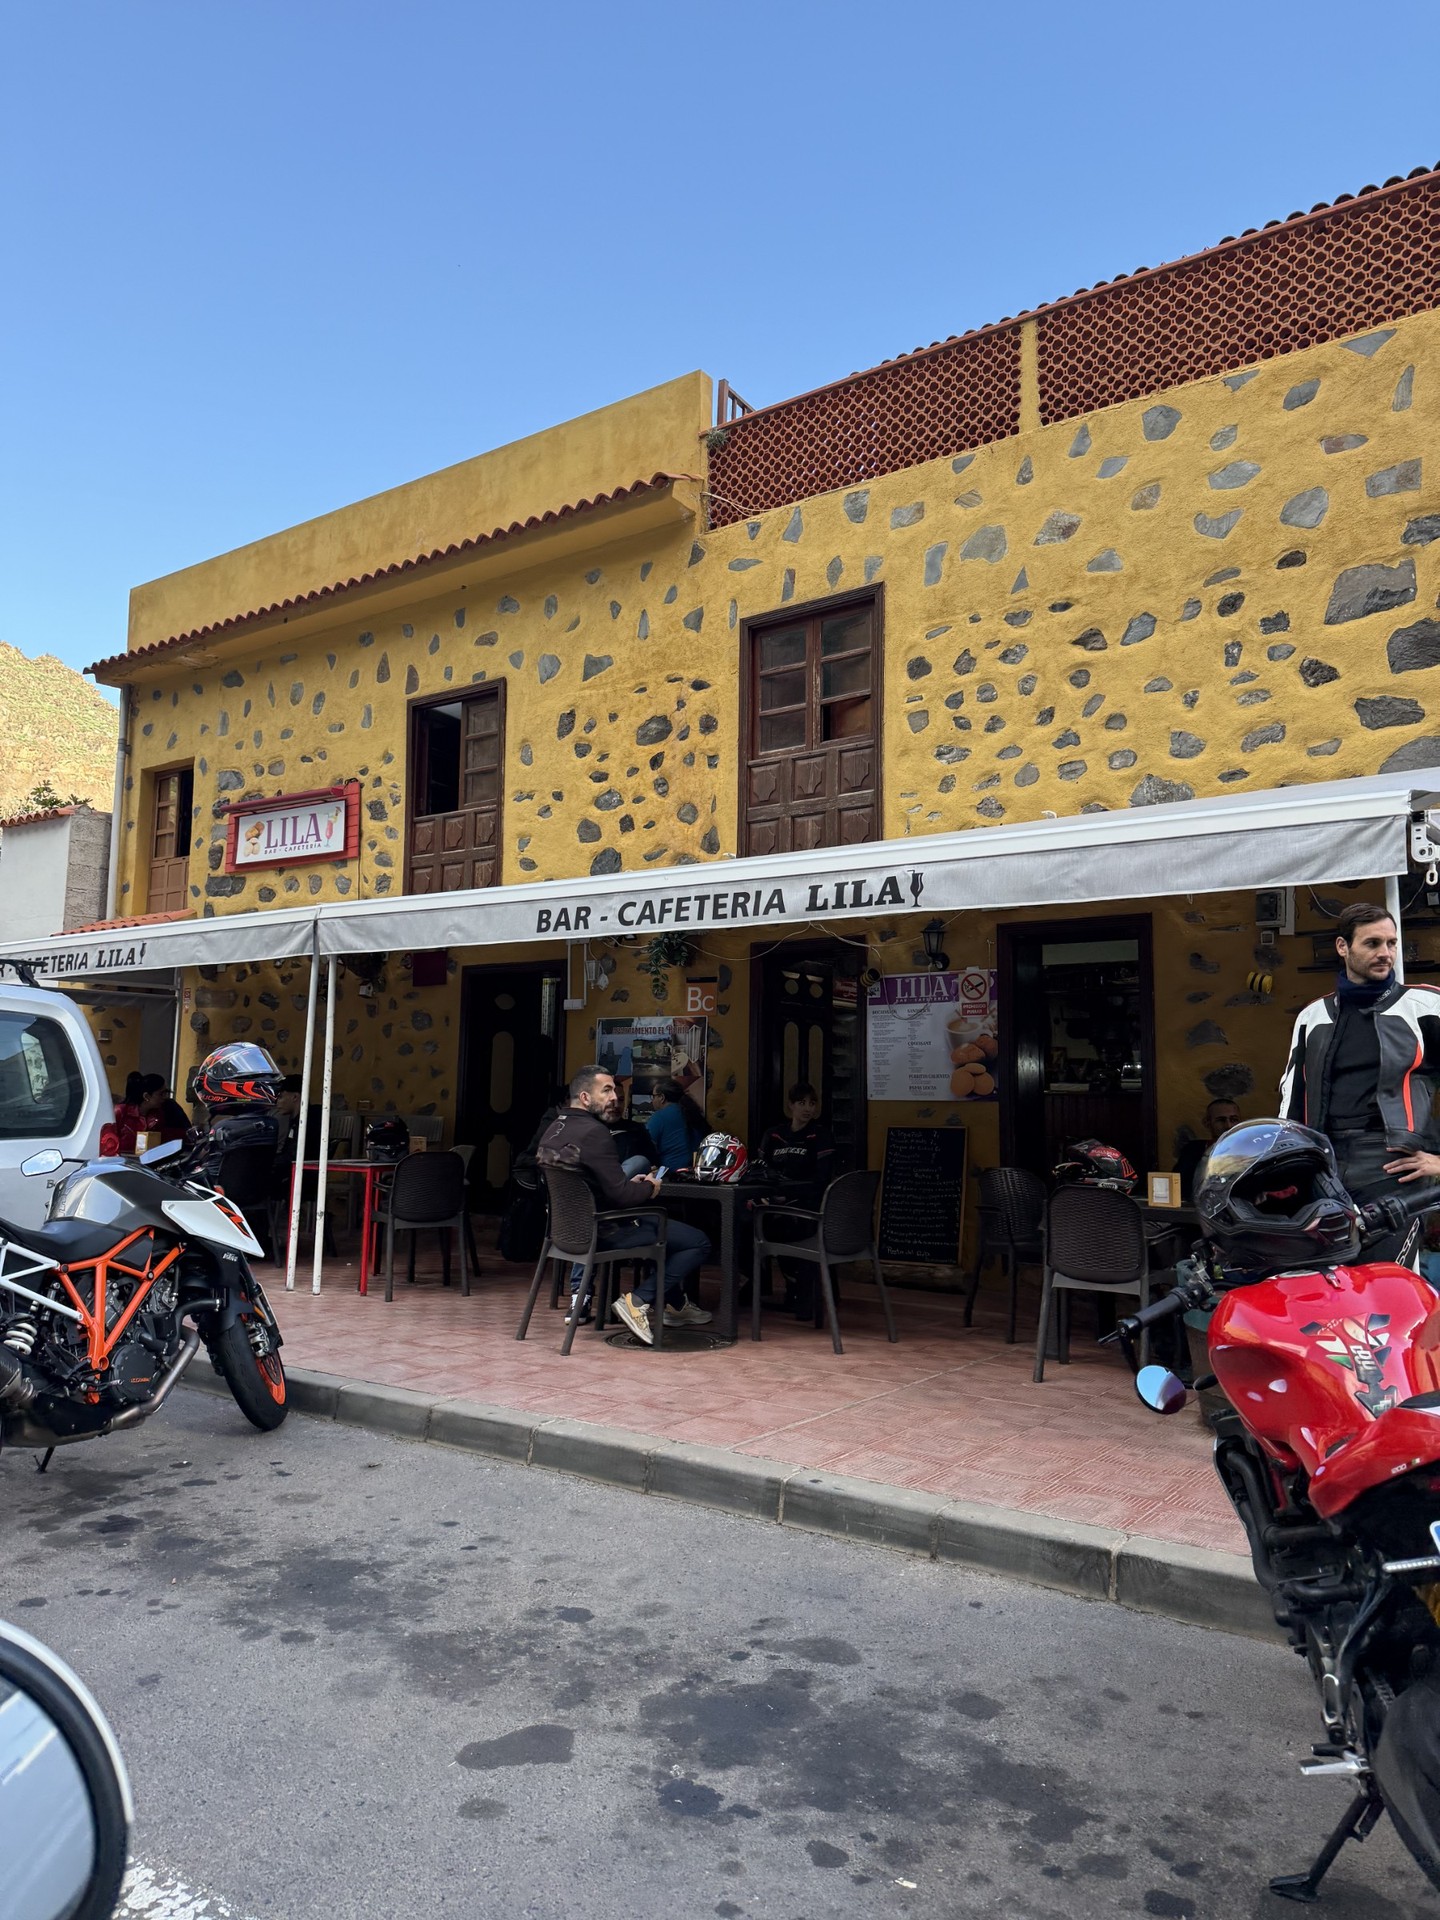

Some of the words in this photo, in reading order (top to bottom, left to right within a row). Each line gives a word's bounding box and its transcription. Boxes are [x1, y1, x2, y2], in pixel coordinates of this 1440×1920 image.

[264, 813, 322, 849] LILA
[536, 906, 592, 933] BAR
[617, 889, 786, 926] CAFETERIA
[805, 875, 905, 912] LILA
[95, 947, 136, 969] LILA
[687, 987, 715, 1012] Bc
[896, 976, 949, 999] LILA
